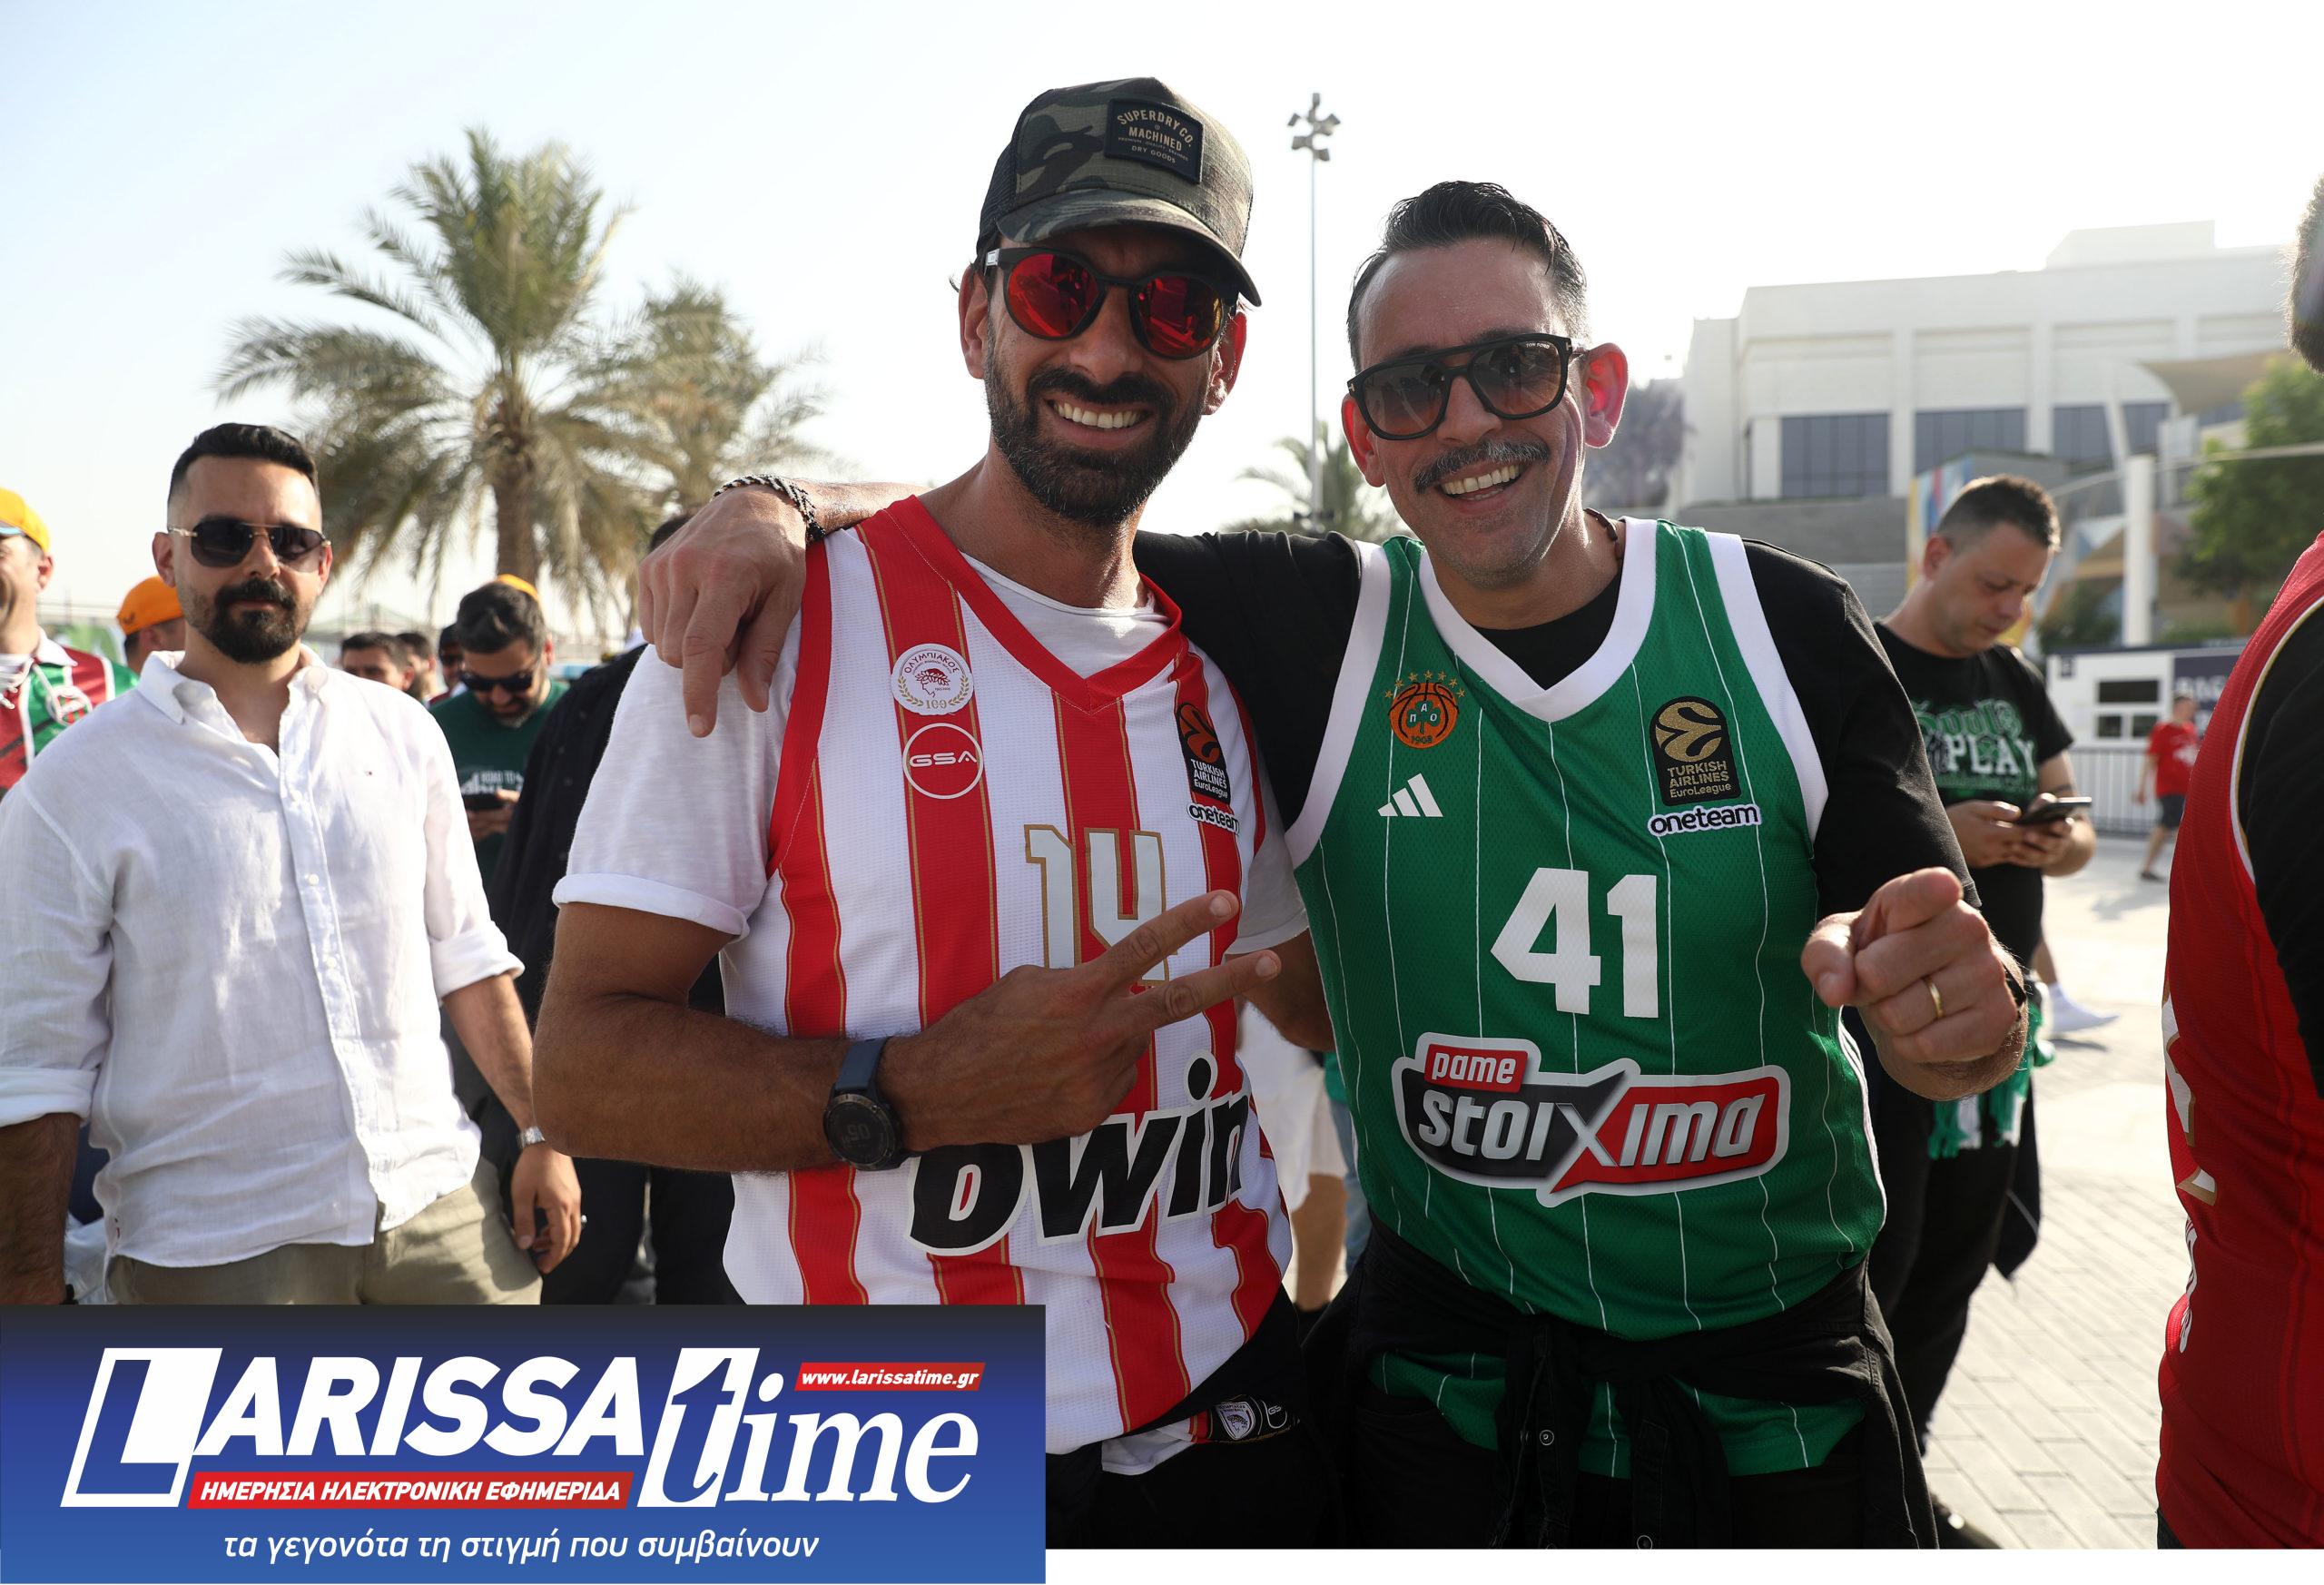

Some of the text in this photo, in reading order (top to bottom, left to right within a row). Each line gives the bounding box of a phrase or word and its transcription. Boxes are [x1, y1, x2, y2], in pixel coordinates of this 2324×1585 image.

[1118, 110, 1194, 147] SUPERDRY CO.
[1128, 127, 1182, 152] MACHINED
[1131, 145, 1147, 153] DRY
[1150, 149, 1176, 163] GOODS
[904, 652, 960, 674] ΟΛΥΜΠΙΑΚΟΣ
[910, 751, 978, 768] GSA
[1945, 733, 2037, 779] PLAY
[1190, 759, 1226, 779] TURKISH
[1194, 769, 1227, 789] AIRLINES
[1667, 761, 1728, 778] TURKISH
[1194, 779, 1228, 799] EuroLeague
[1670, 771, 1729, 789] AIRLINES
[1669, 783, 1732, 799] EuroLeague
[1188, 804, 1239, 833] oneteam
[1649, 806, 1758, 834] oneteam
[1024, 824, 1177, 987] 14
[1491, 867, 1659, 1019] 41
[1431, 1051, 1517, 1085] pame
[1268, 1404, 1283, 1415] GS
